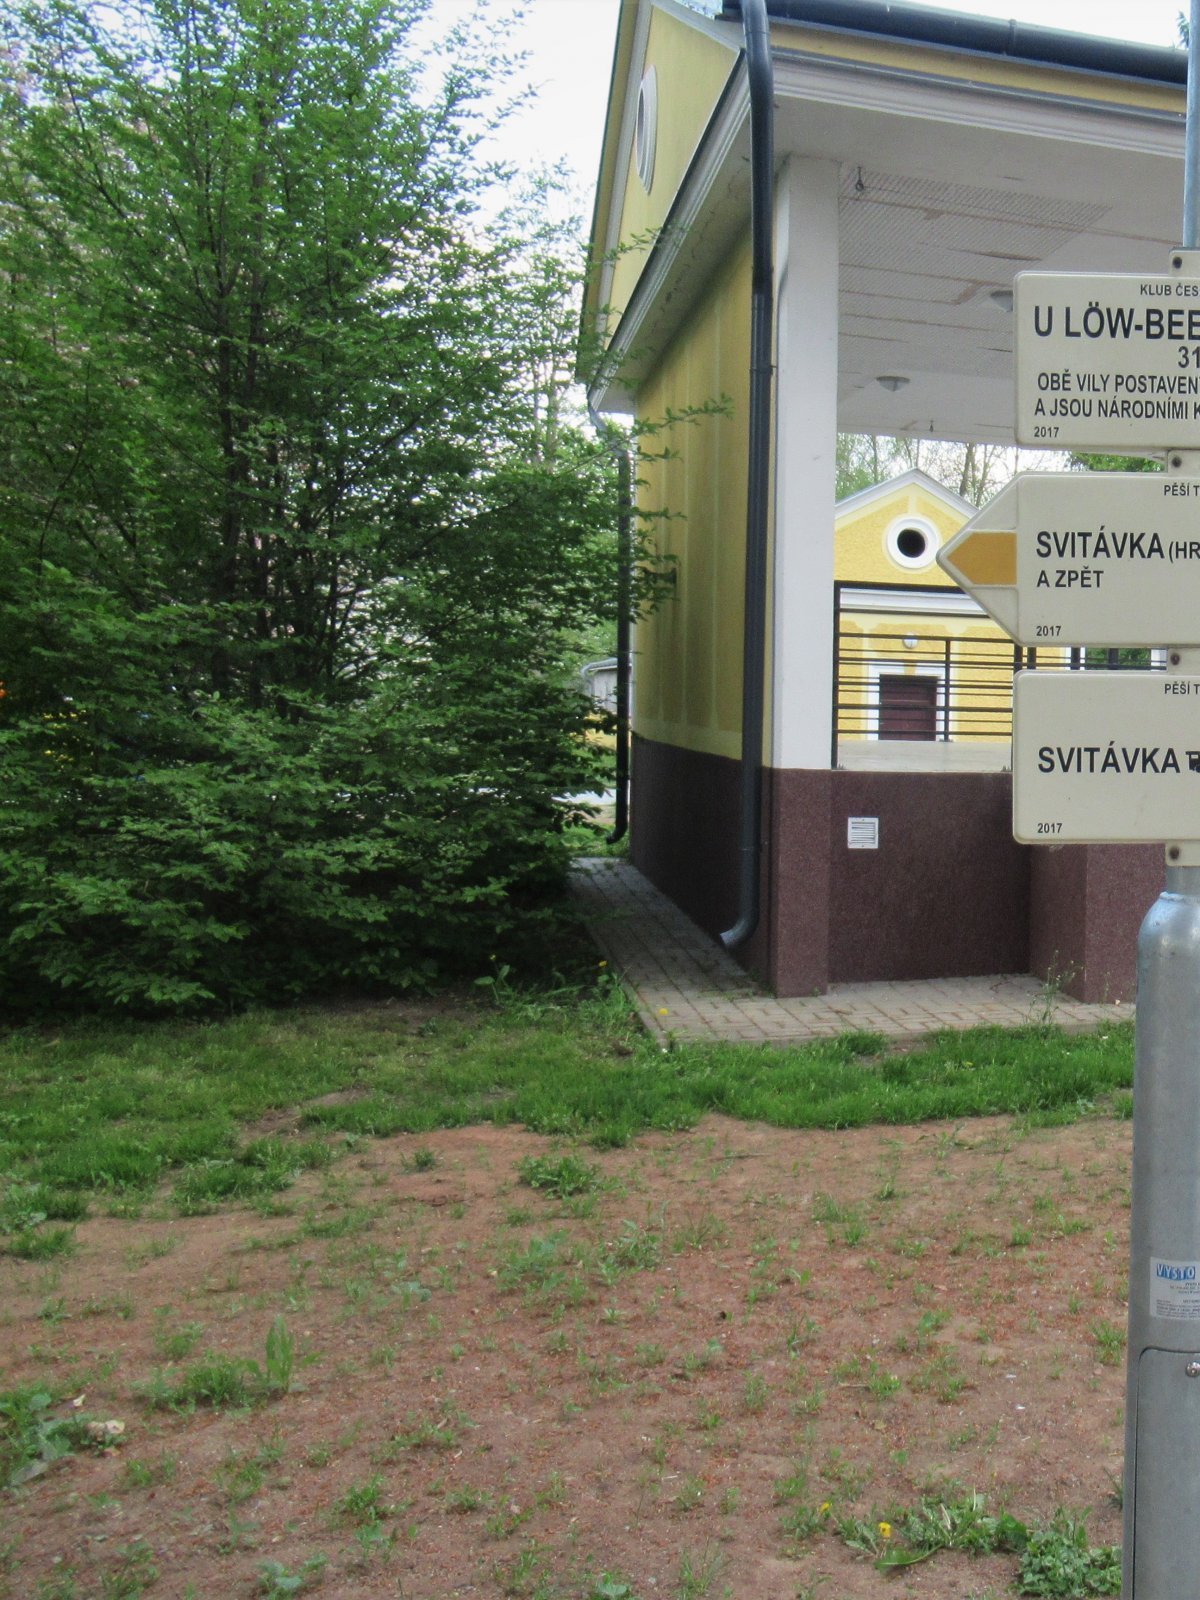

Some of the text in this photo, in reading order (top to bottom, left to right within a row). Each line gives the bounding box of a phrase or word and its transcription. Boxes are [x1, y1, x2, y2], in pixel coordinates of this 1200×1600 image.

[1140, 283, 1172, 297] KLUB
[1034, 305, 1053, 337] U
[1037, 368, 1072, 392] OBĚ
[1076, 373, 1111, 393] VILY
[1034, 397, 1046, 417] A
[1049, 398, 1093, 418] JSOU
[1097, 395, 1189, 420] NÁRODNÍMI
[1033, 425, 1060, 438] 2017
[1163, 482, 1190, 497] PĚŠÍ
[1036, 525, 1165, 559] SVITÁVKA
[1036, 565, 1105, 588] A ZPĚT
[1036, 625, 1062, 637] 2017
[1164, 680, 1191, 695] PĚŠÍ
[1037, 740, 1181, 774] SVITÁVKA
[1037, 822, 1063, 834] 2017
